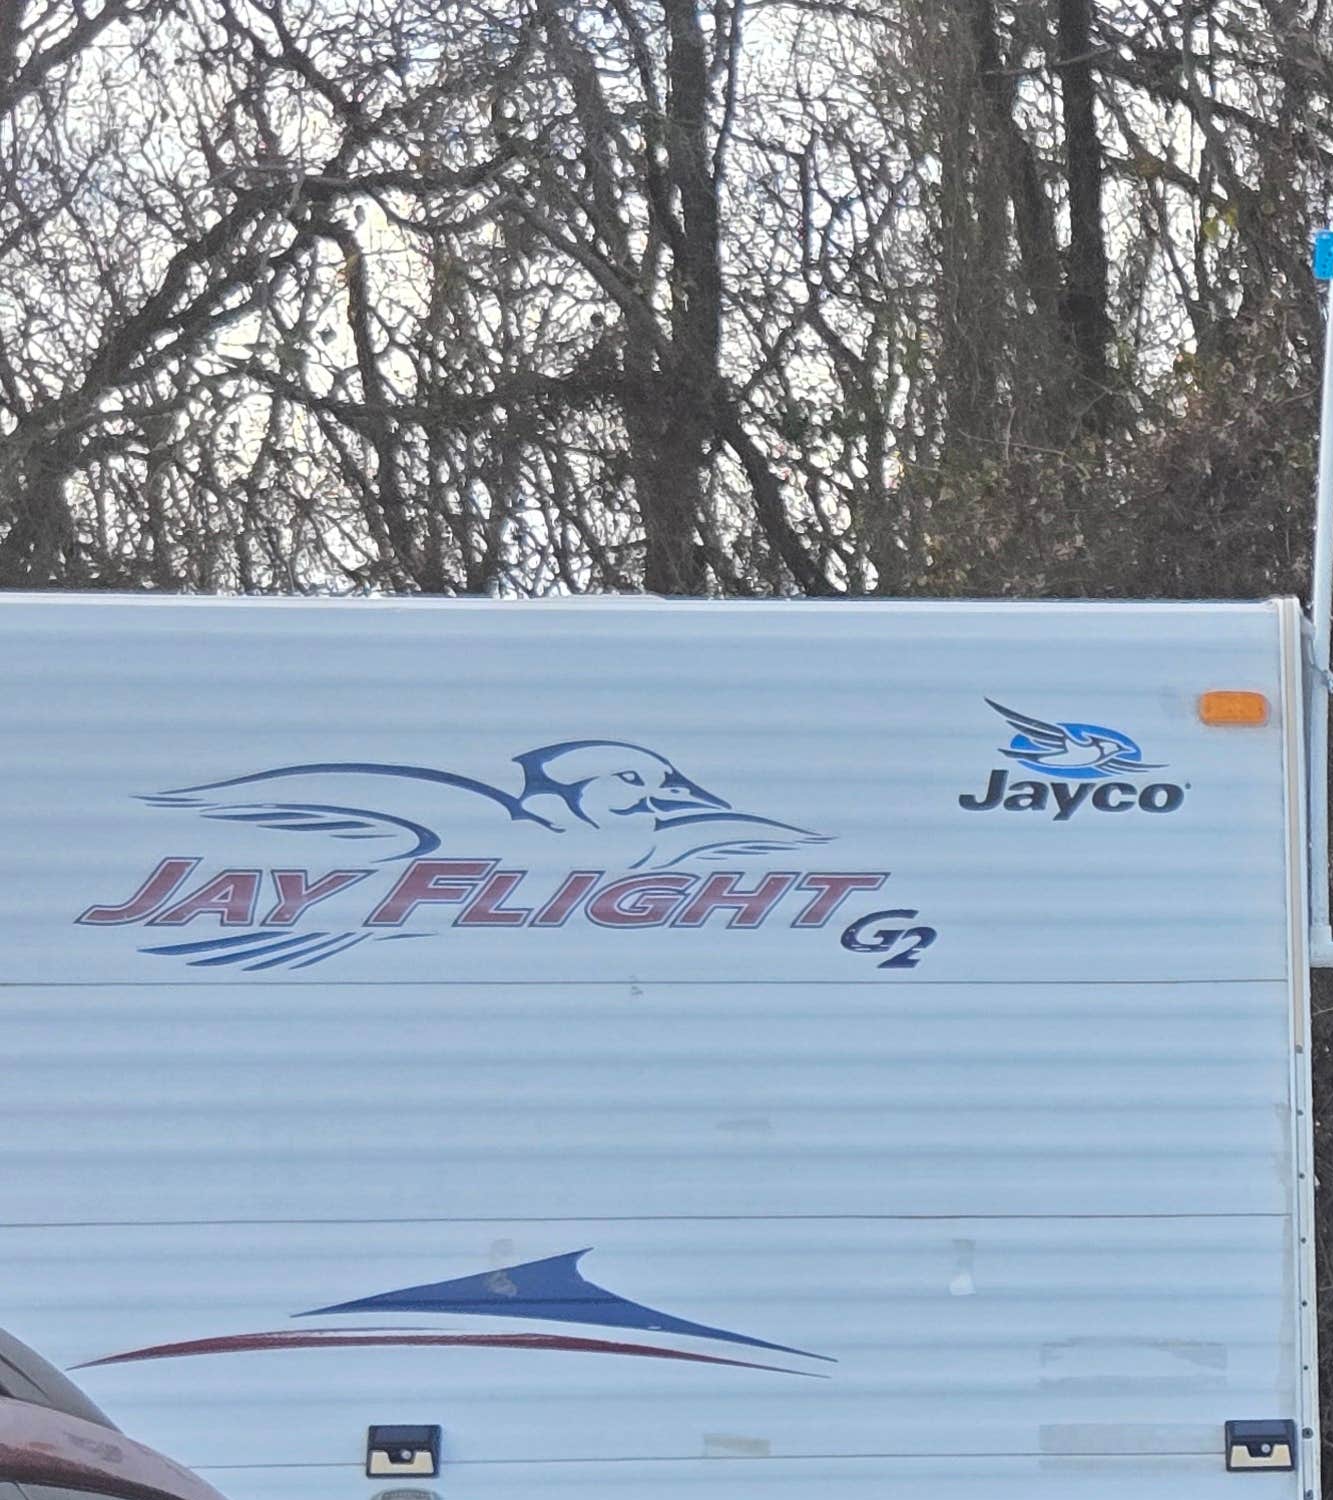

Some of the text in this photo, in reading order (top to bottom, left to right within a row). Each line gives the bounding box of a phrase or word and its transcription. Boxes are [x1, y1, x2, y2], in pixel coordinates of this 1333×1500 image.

[958, 769, 1185, 821] Jayco
[74, 856, 937, 969] JAY FLIGHT G2
